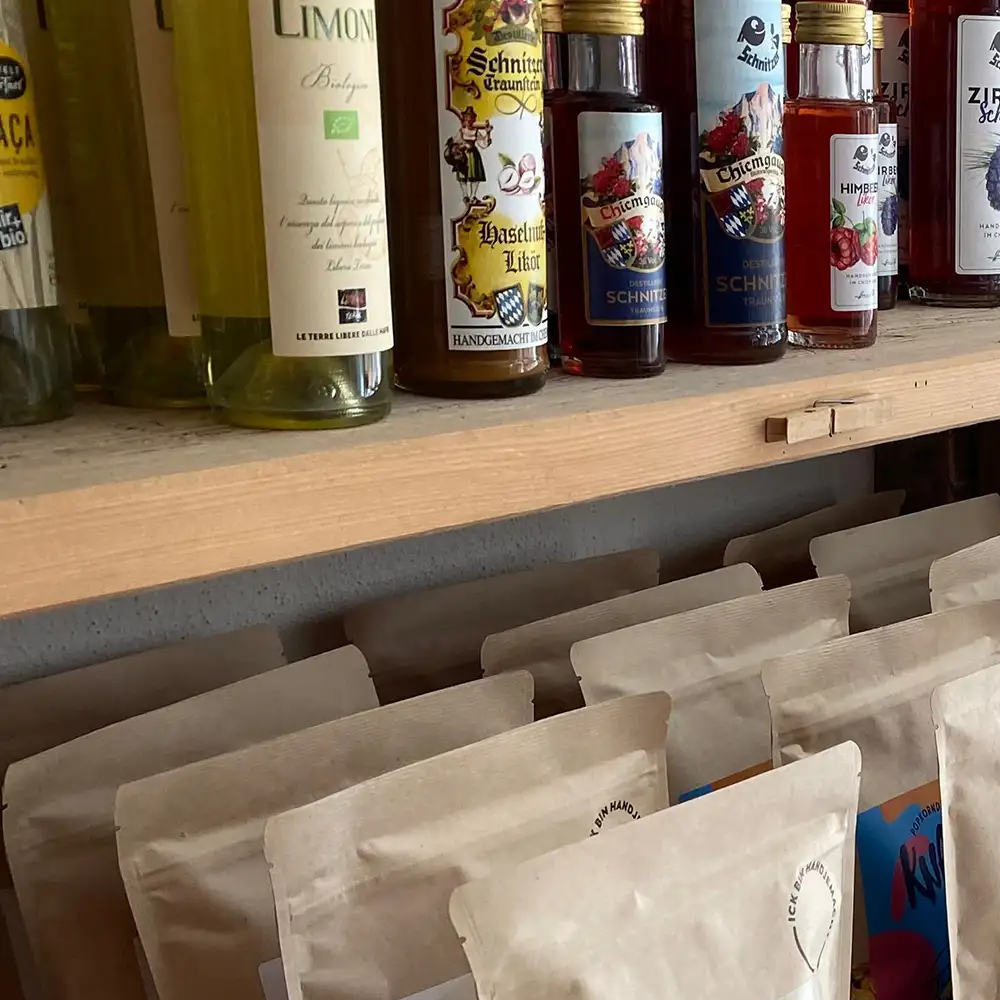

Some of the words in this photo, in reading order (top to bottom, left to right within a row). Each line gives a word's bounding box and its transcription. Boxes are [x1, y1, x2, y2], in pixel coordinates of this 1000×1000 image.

[0, 228, 26, 248] bio
[296, 332, 307, 341] LE
[308, 332, 334, 341] TERRE
[335, 331, 360, 340] LIBERE
[452, 333, 530, 347] HANDGEMACHT
[594, 805, 609, 829] BIN
[793, 867, 805, 892] BIN
[788, 893, 799, 922] ICK
